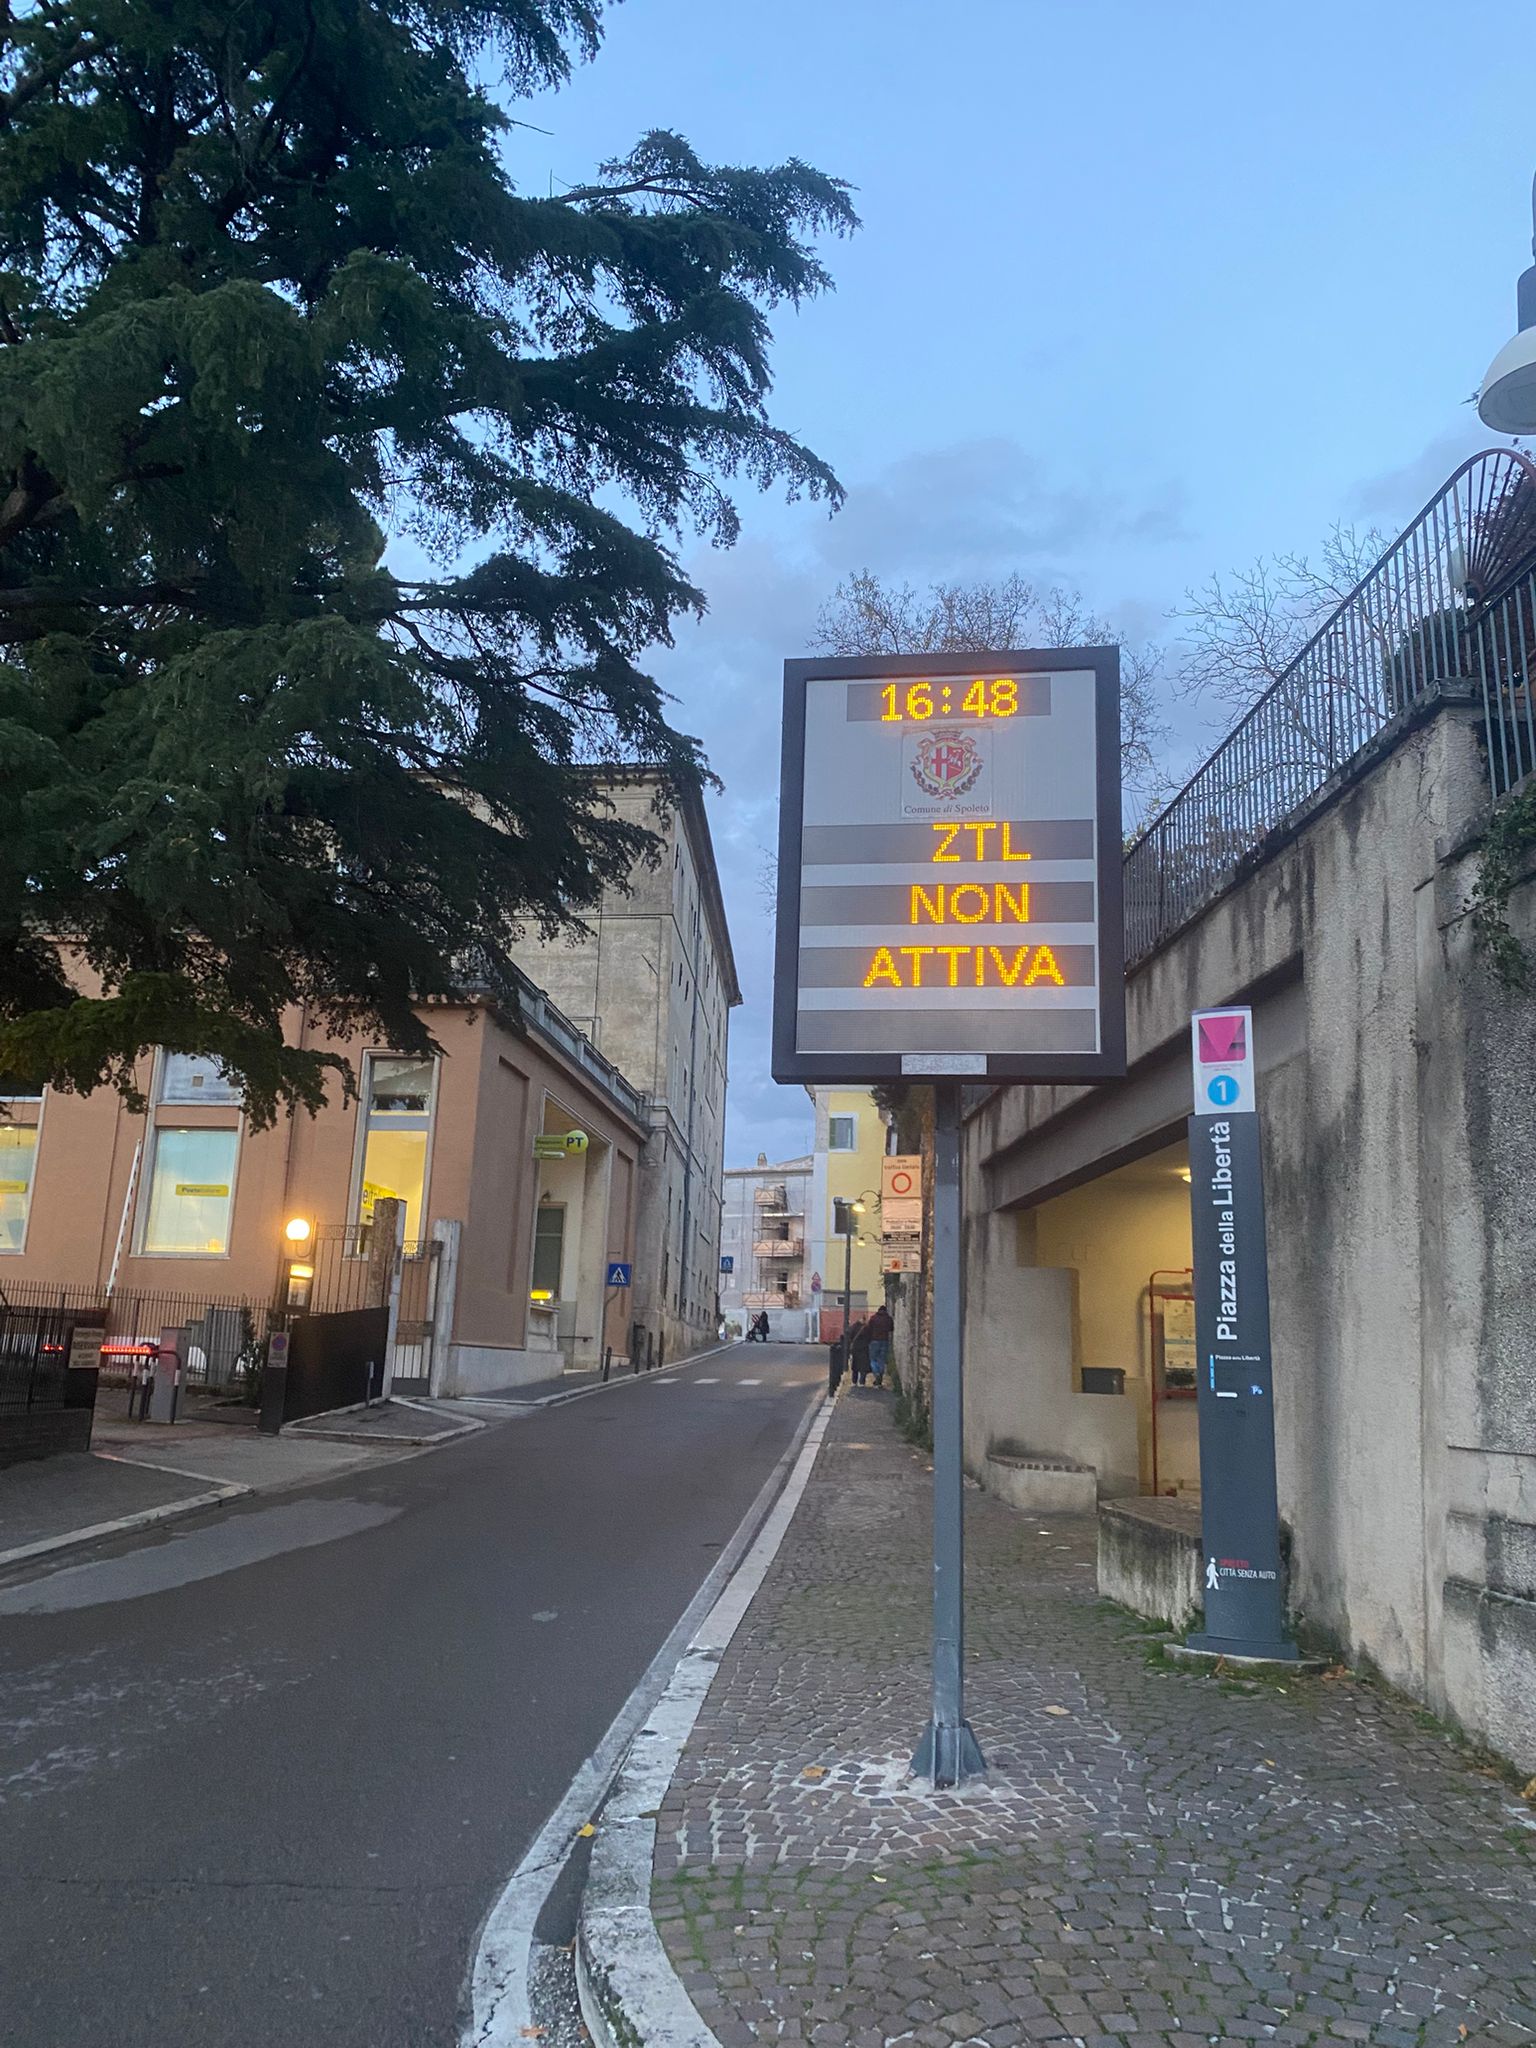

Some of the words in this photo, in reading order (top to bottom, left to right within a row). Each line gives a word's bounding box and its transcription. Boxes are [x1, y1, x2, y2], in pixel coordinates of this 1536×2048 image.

[881, 679, 1019, 721] 16:48
[904, 805, 941, 814] Comune
[944, 804, 952, 813] di
[954, 804, 989, 815] Spoleto
[932, 822, 1031, 863] ZTL
[911, 882, 1030, 924] NON
[864, 945, 1065, 987] ATTIVA
[1217, 1080, 1227, 1102] 1
[566, 1136, 584, 1148] PT
[1209, 1121, 1234, 1206] Libertà
[1218, 1211, 1235, 1255] della
[1217, 1259, 1238, 1340] Piazza
[1237, 1569, 1257, 1579] SENZA
[1258, 1570, 1276, 1580] AUTO
